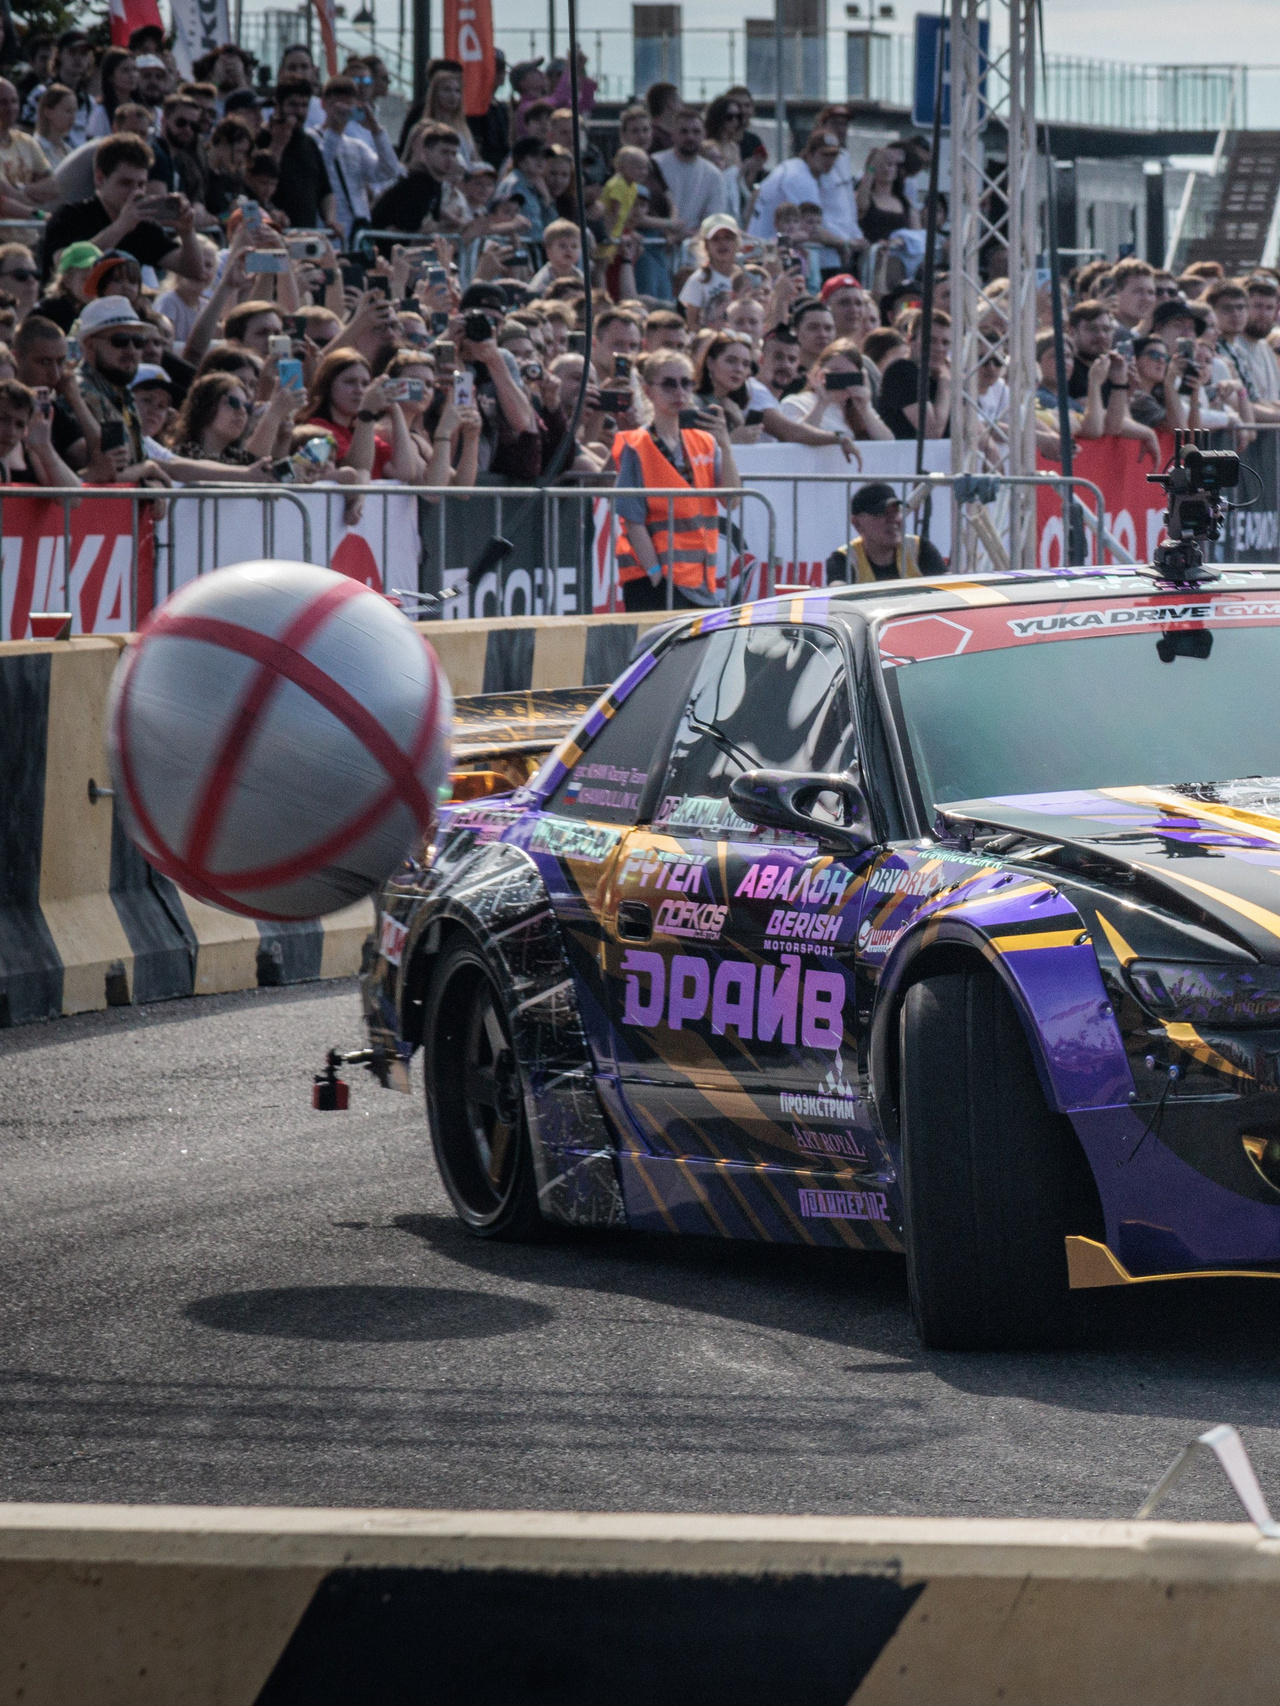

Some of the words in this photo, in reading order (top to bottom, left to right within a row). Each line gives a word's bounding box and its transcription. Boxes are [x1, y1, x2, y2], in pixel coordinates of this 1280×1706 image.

[1012, 612, 1103, 637] YUKA
[1109, 604, 1213, 627] DRIVE
[734, 863, 855, 908] АВАЛОН
[766, 910, 843, 941] BERISH
[764, 939, 835, 957] MOTORSPORT
[780, 1092, 855, 1120] ПРОЭКСТРИМ
